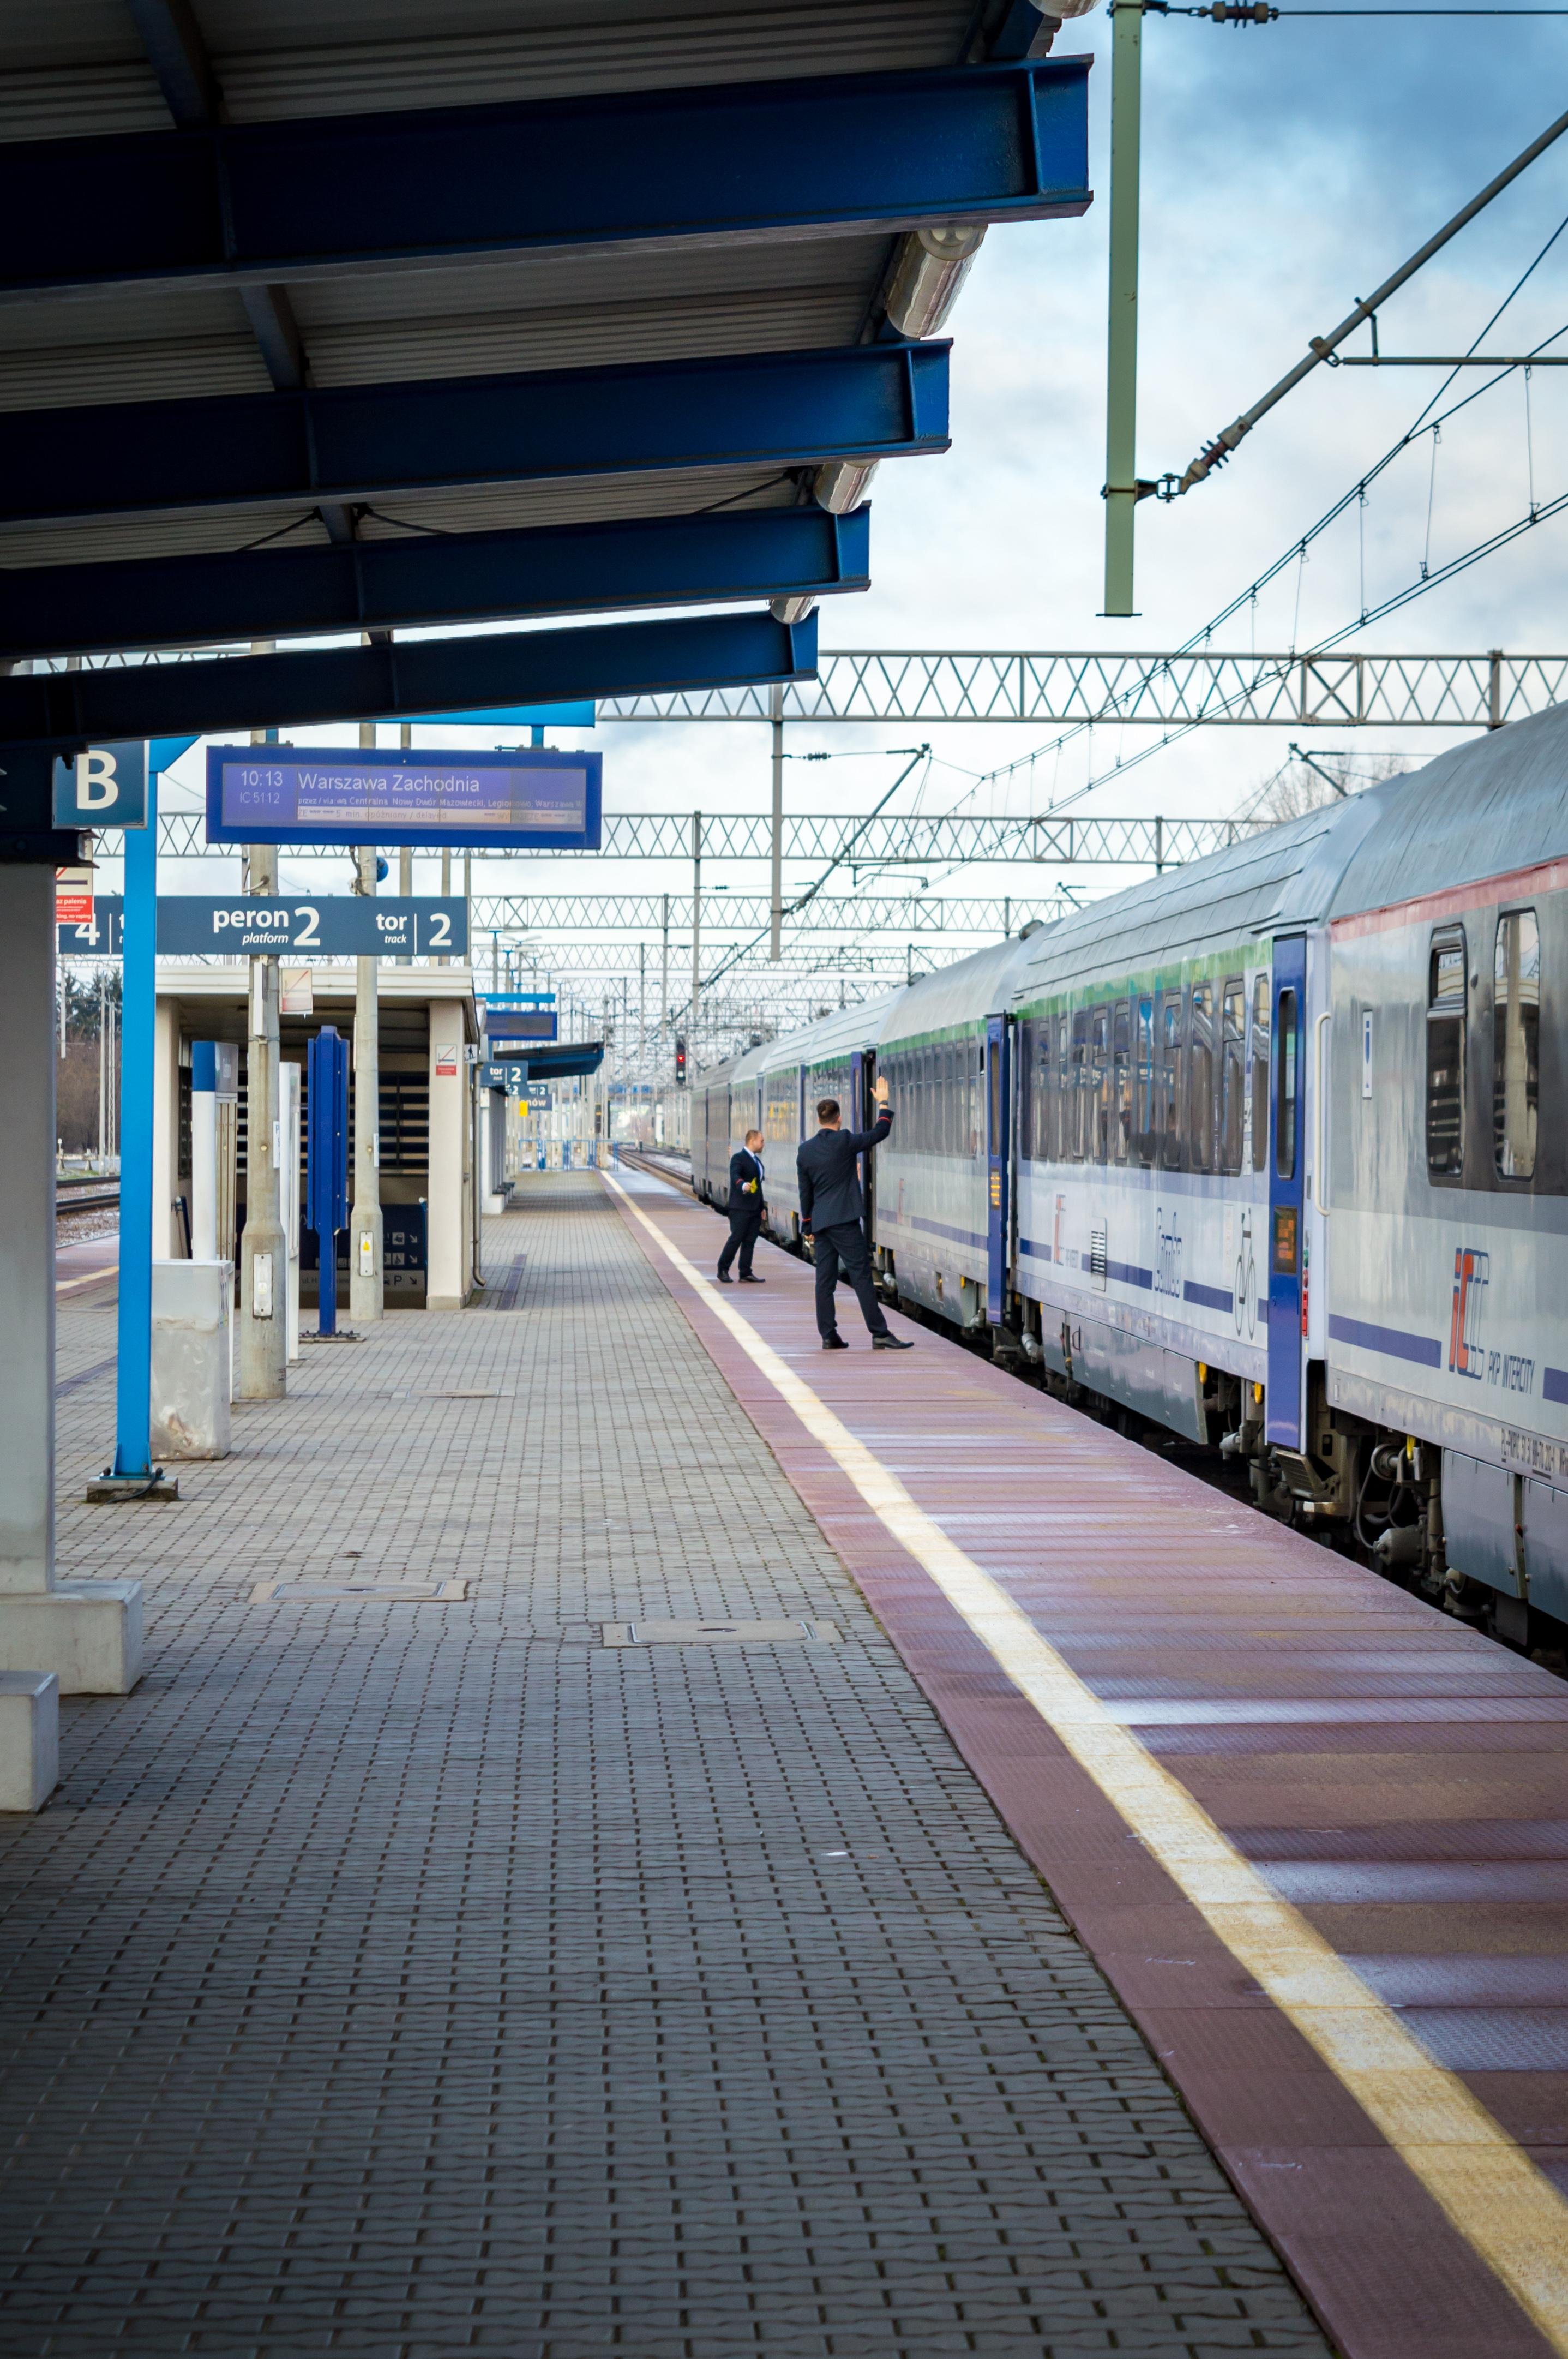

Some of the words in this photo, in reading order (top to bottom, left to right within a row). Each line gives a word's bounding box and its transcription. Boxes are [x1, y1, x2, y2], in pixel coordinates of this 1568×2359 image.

[77, 750, 119, 810] B
[241, 770, 283, 786] 10:13
[298, 773, 387, 791] Warszawa
[392, 774, 480, 792] Zachodnia
[240, 791, 251, 803] IC
[253, 792, 280, 804] 5112
[349, 796, 388, 806] Centralna
[392, 797, 413, 807] Nowy
[416, 796, 437, 806] Dwór
[440, 798, 485, 808] Mazowiecki,
[536, 799, 574, 809] Warszawa
[75, 913, 100, 946] 4
[213, 909, 289, 933] peron
[293, 906, 321, 947] 2
[375, 913, 407, 931] tor
[429, 913, 452, 947] 2
[242, 932, 289, 945] platform
[385, 934, 407, 943] track
[490, 1067, 503, 1075] tor
[511, 1067, 521, 1082] 2
[512, 1085, 519, 1095] 2
[540, 1086, 545, 1095] 2
[394, 1274, 402, 1286] P
[1487, 1350, 1501, 1386] PKP
[1501, 1354, 1535, 1394] INTERCITY
